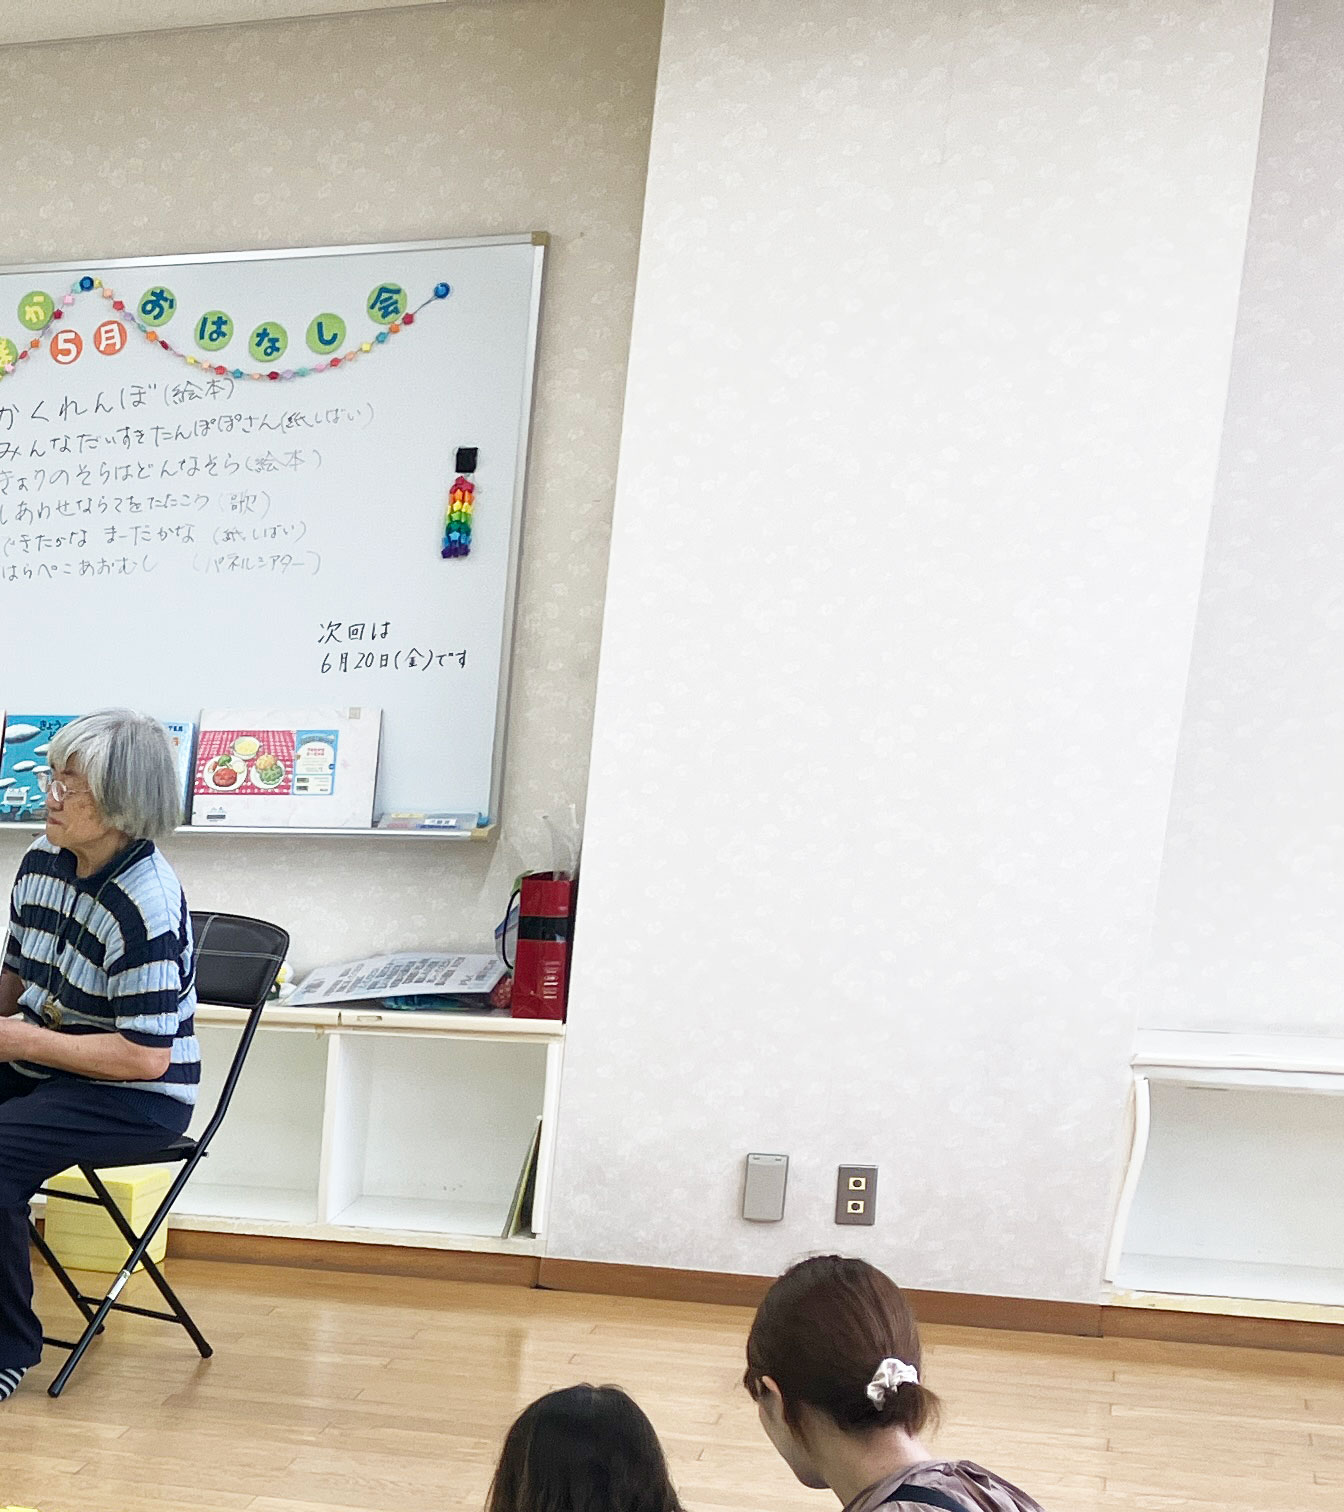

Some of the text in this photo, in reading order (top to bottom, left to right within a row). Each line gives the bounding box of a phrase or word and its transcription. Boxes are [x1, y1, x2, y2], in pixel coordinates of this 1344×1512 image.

[56, 323, 122, 364] 5月
[141, 286, 402, 357] おはなし会
[318, 621, 392, 644] 次回は
